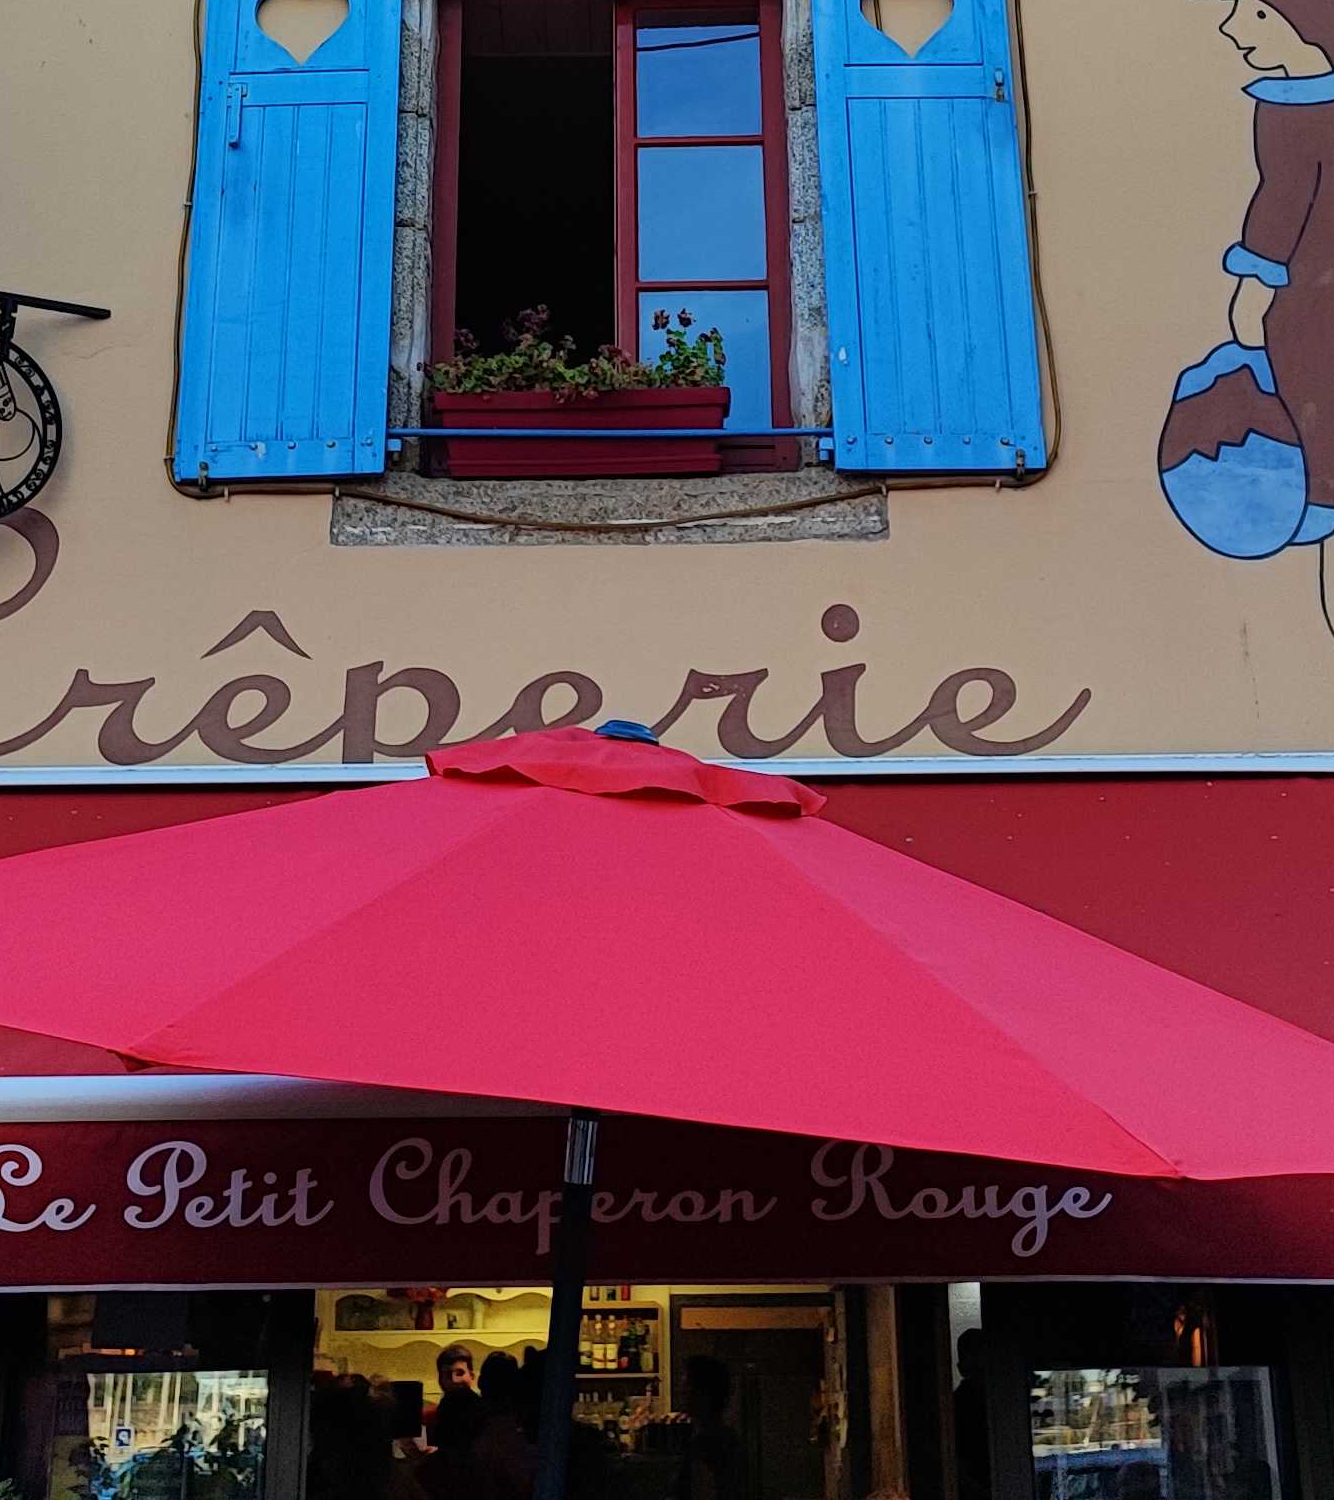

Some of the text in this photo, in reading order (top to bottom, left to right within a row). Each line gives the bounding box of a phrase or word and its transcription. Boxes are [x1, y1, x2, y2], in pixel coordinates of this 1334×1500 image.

[123, 1140, 335, 1229] Petit
[369, 1137, 778, 1255] Chaperon
[810, 1138, 1113, 1257] Rouge
